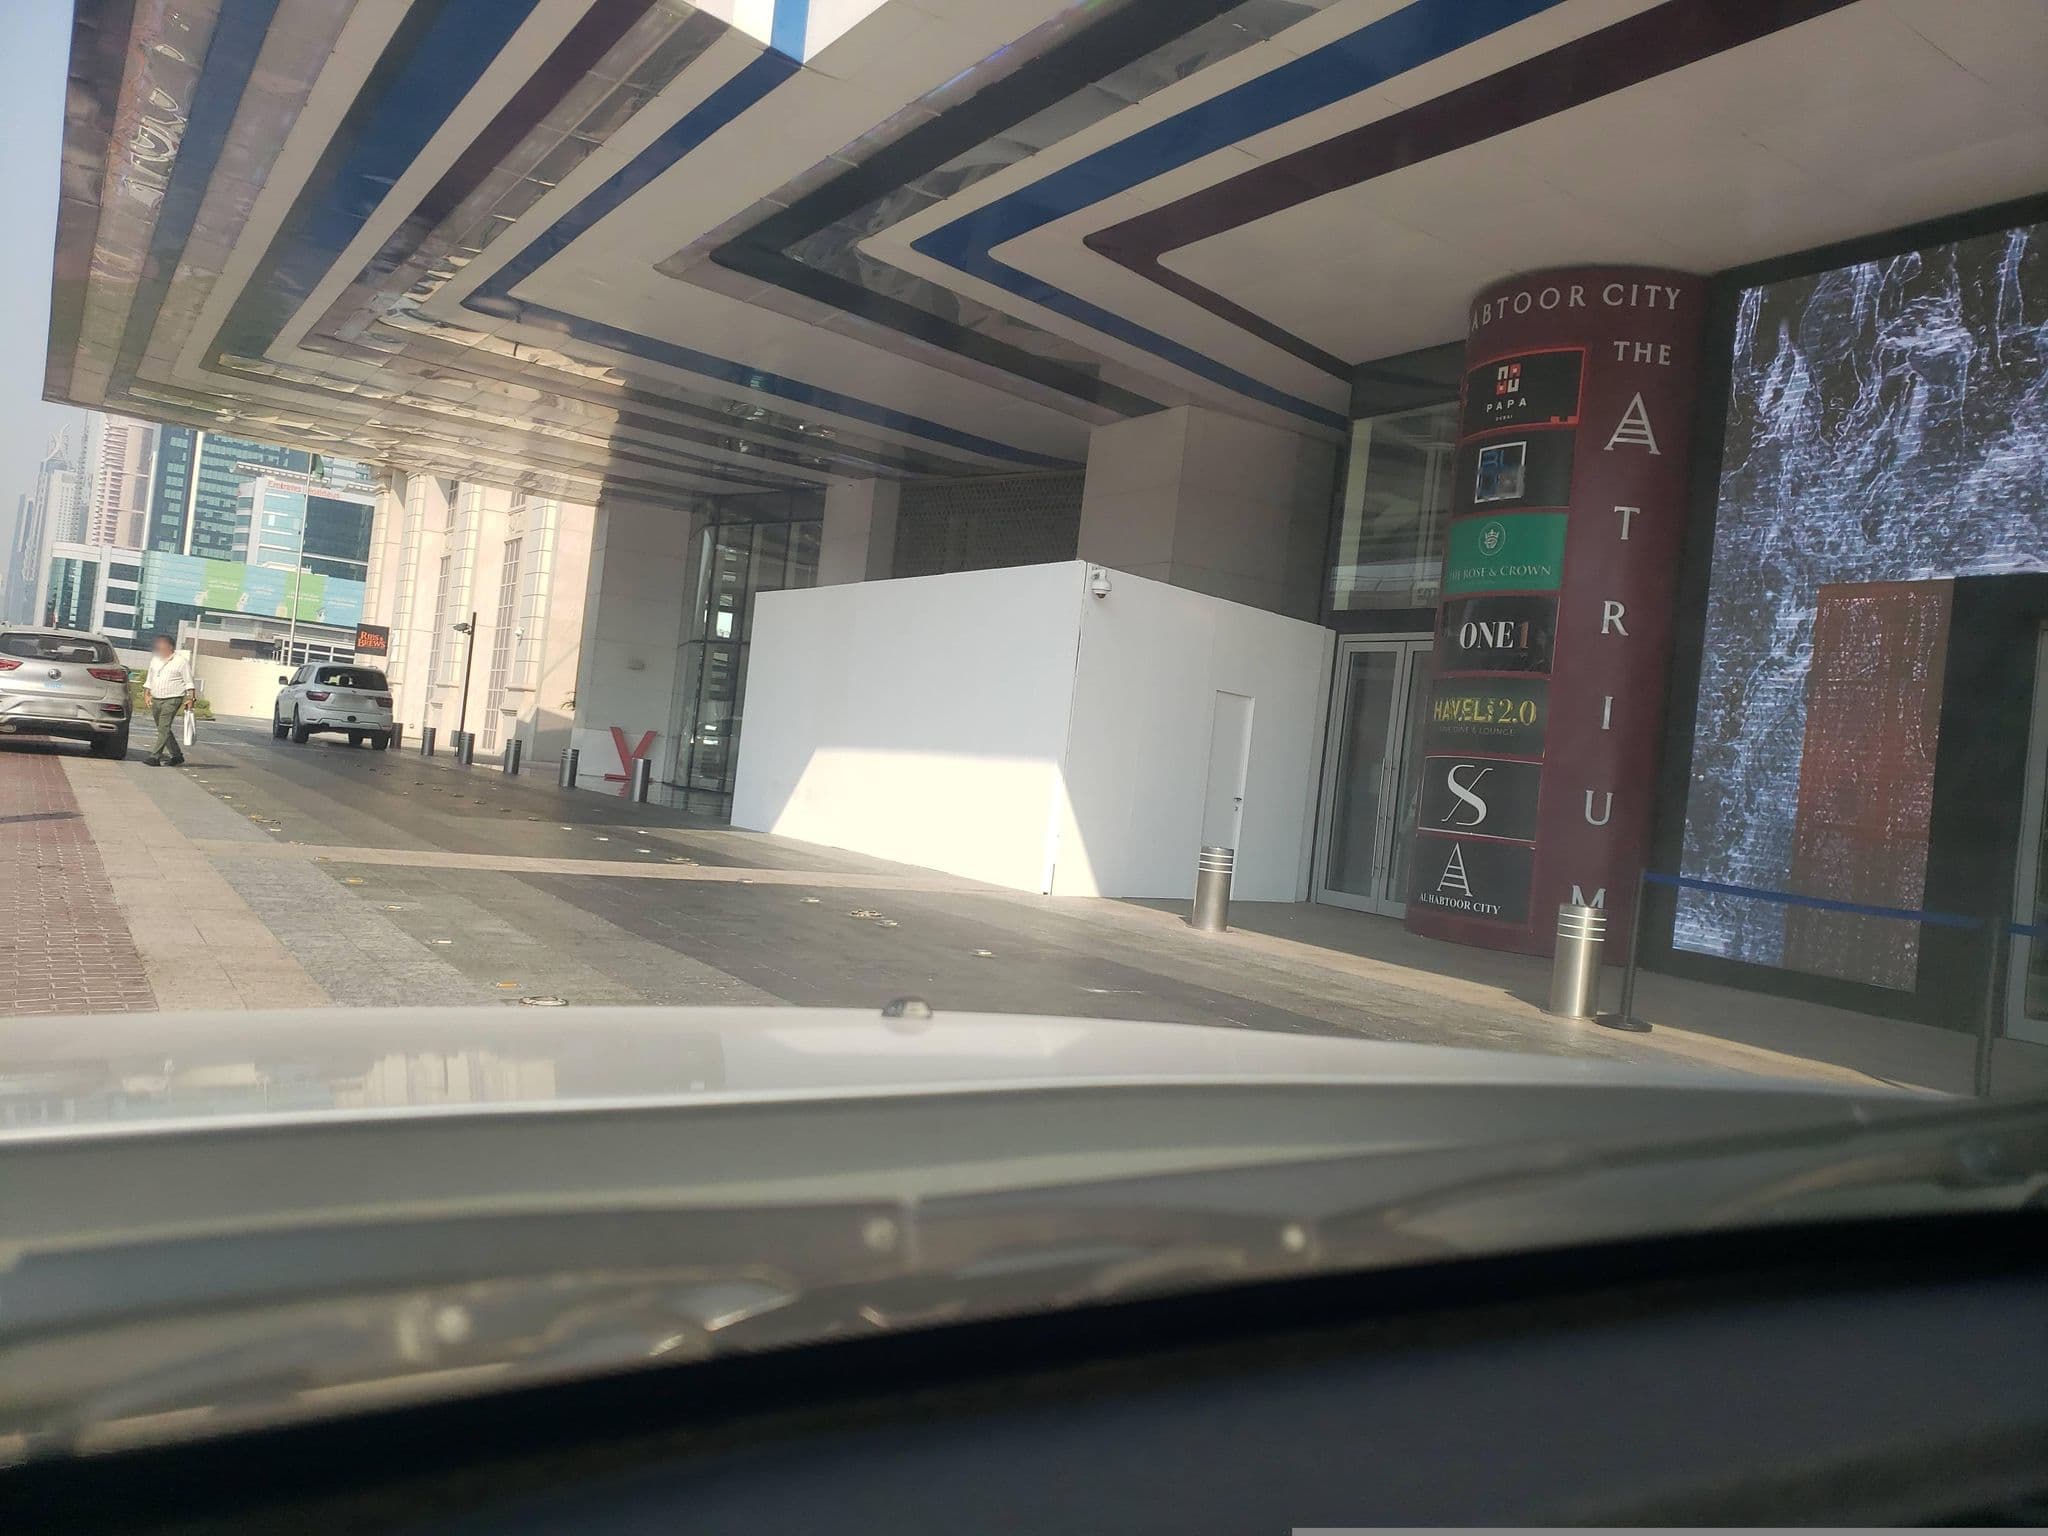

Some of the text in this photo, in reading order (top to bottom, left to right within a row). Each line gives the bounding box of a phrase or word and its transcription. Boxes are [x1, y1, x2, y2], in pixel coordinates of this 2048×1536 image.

[1602, 283, 1681, 310] CITY
[1613, 340, 1672, 366] THE
[1486, 397, 1527, 413] PAPA
[1463, 566, 1486, 580] ROSE
[1489, 568, 1498, 578] &
[1500, 565, 1552, 577] CROWN
[1459, 621, 1515, 649] ONE
[1497, 697, 1537, 726] 2.0
[1420, 892, 1502, 915] AL HABTOOR CITY
